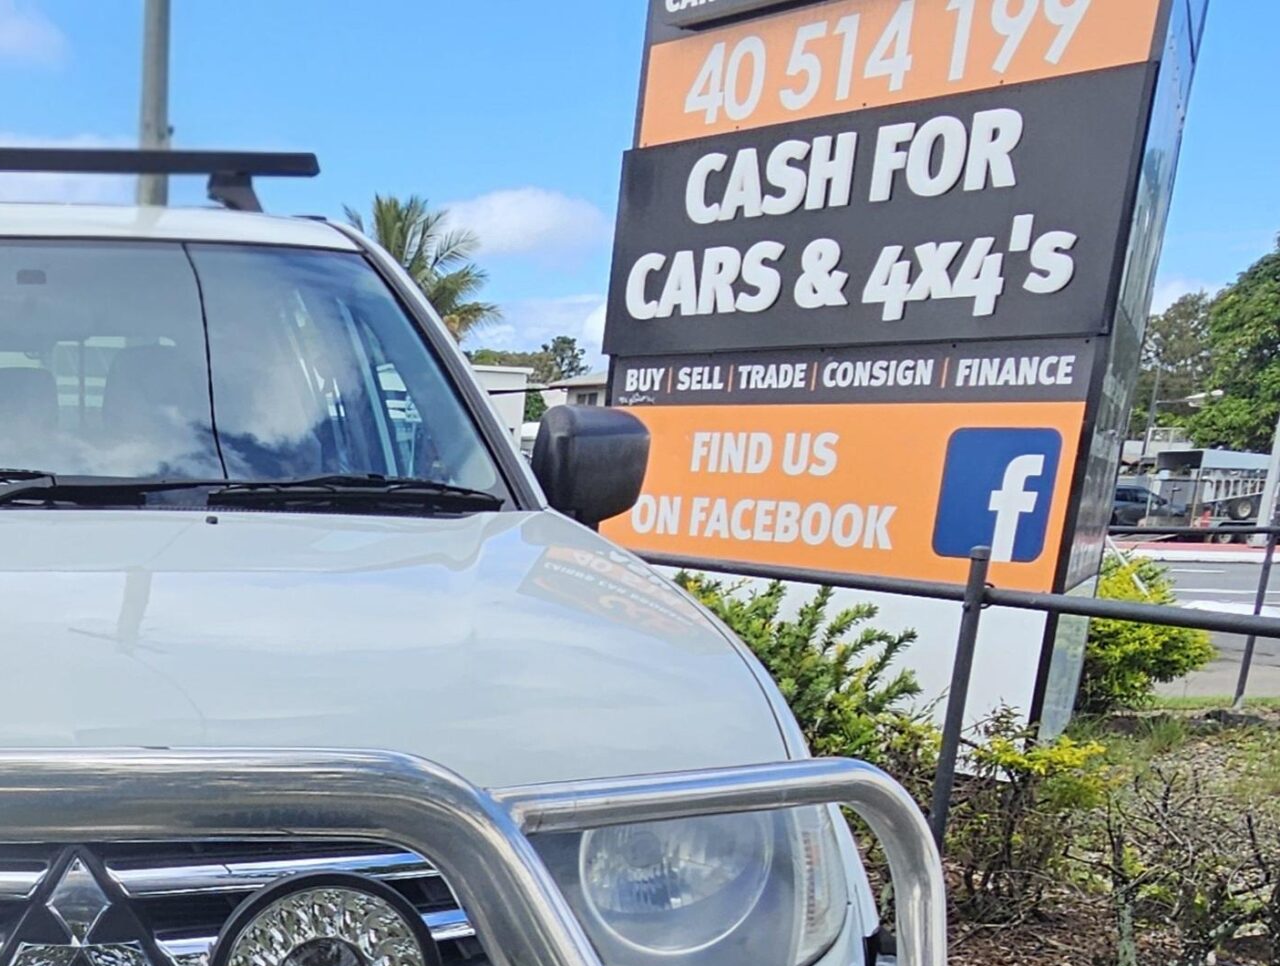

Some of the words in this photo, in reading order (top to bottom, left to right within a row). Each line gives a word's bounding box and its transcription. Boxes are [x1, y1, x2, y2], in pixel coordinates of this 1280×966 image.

[684, 35, 767, 125] 40
[779, 0, 916, 111] 514
[945, 0, 1093, 81] 199
[685, 131, 858, 224] CASH
[869, 108, 1024, 202] FOR
[625, 240, 786, 320] CARS
[793, 238, 849, 309] &
[625, 368, 665, 392] BUY
[676, 366, 724, 390] SELL
[738, 363, 808, 389] TRADE
[822, 359, 934, 388] CONSIGN
[955, 355, 1076, 387] FINANCE
[690, 432, 773, 474] FIND
[782, 432, 840, 476] US
[631, 494, 682, 535] ON
[689, 497, 897, 550] FACEBOOK
[988, 454, 1045, 562] f
